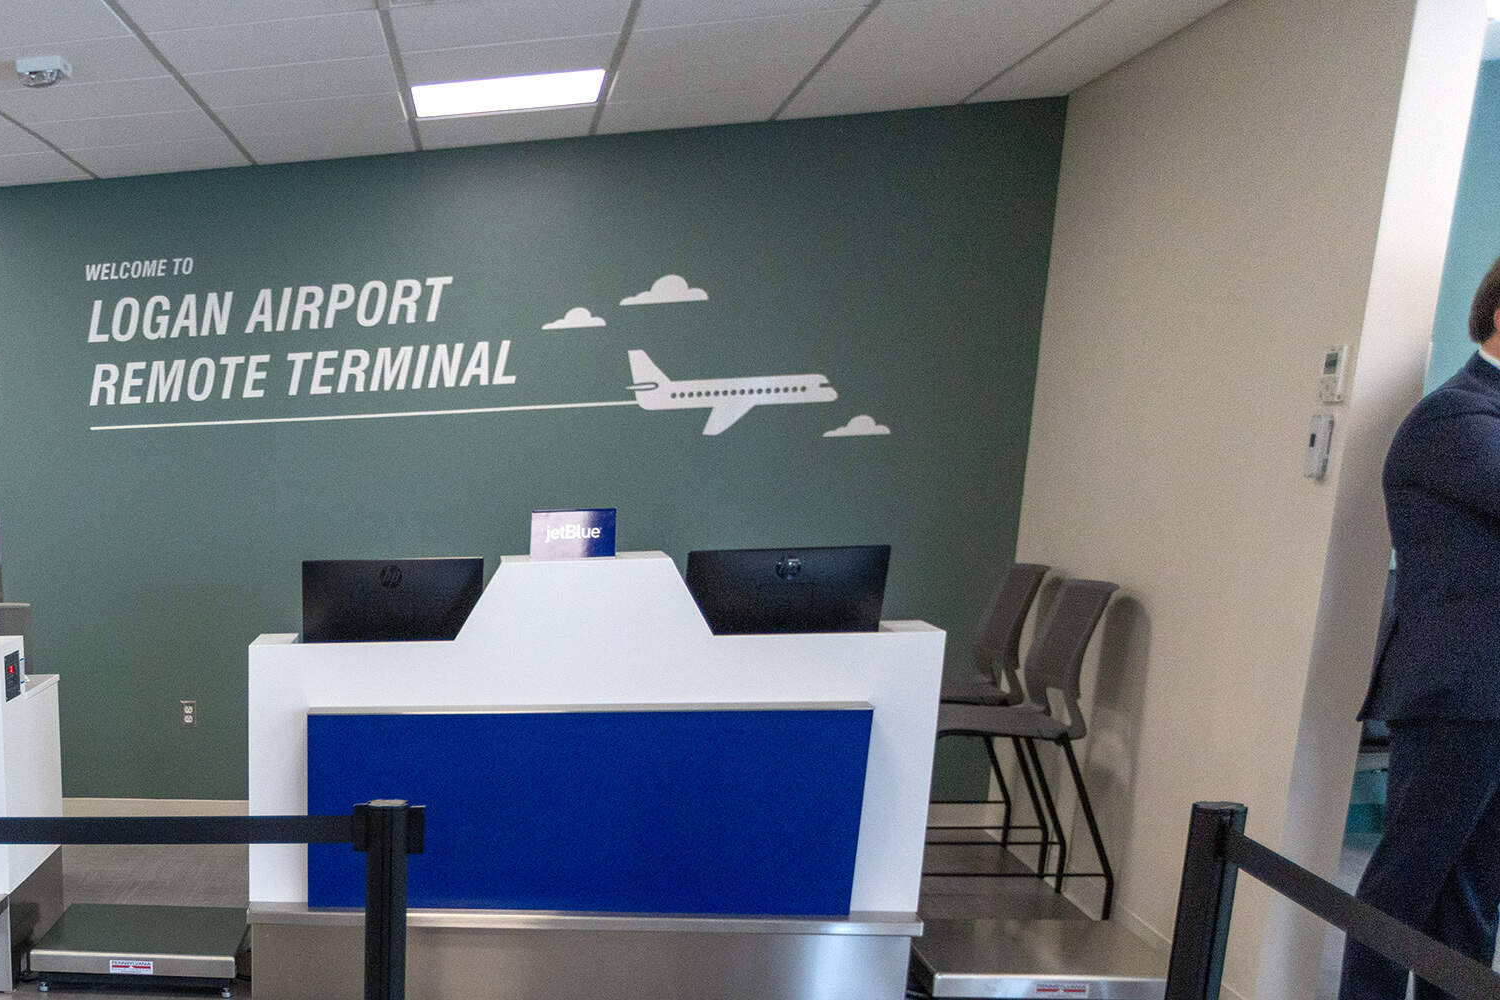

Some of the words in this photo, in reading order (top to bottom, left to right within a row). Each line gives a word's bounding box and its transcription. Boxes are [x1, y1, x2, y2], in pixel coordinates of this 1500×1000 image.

[85, 259, 167, 281] WELCOME
[172, 257, 194, 275] TO
[88, 291, 234, 343] LOGAN
[244, 276, 453, 333] AIRPORT
[89, 354, 271, 406] REMOTE
[287, 340, 517, 396] TERMINAL
[544, 524, 601, 543] jetBlue
